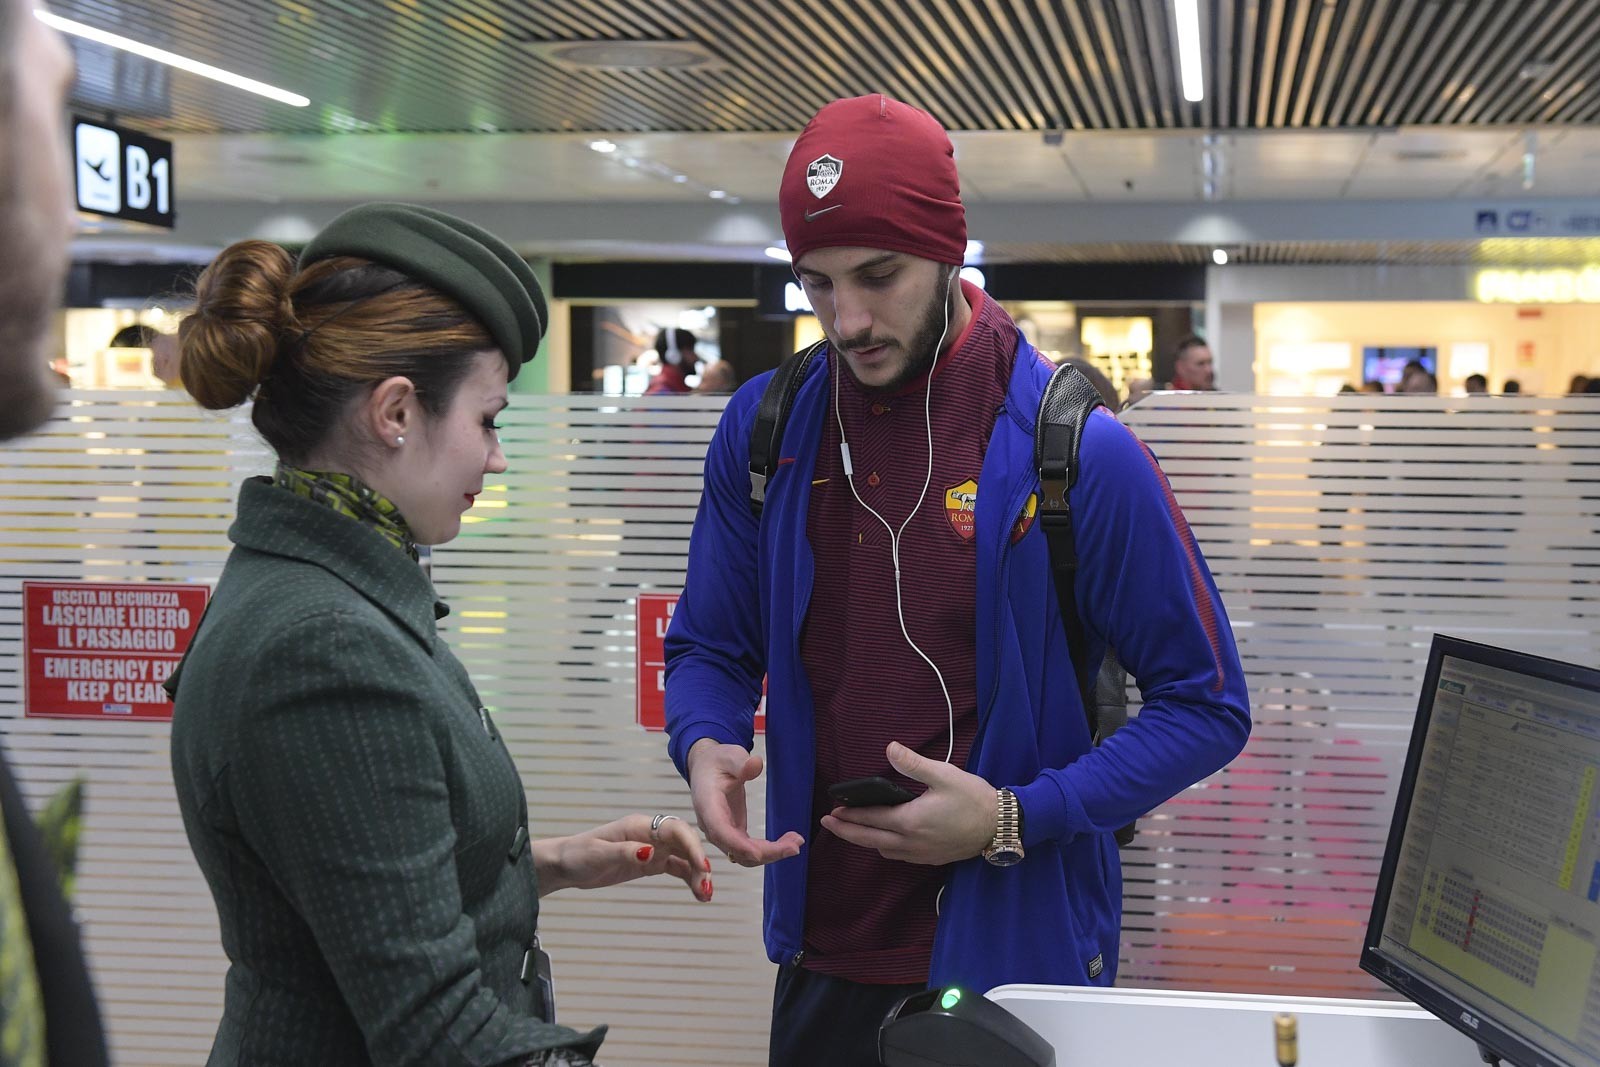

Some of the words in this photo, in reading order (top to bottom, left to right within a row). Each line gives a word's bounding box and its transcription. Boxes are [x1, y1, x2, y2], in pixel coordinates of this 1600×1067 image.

[126, 145, 168, 214] B1
[951, 513, 974, 522] ROM
[53, 590, 96, 605] USCITA
[99, 591, 112, 605] DI
[115, 592, 179, 607] SICUREZZA
[43, 605, 125, 627] LASCIARE
[130, 607, 190, 629] LIBERO
[58, 628, 72, 647] IL
[77, 628, 175, 650] PASSAGGIO
[44, 657, 149, 680] EMERGENCY
[67, 680, 110, 701] KEEP
